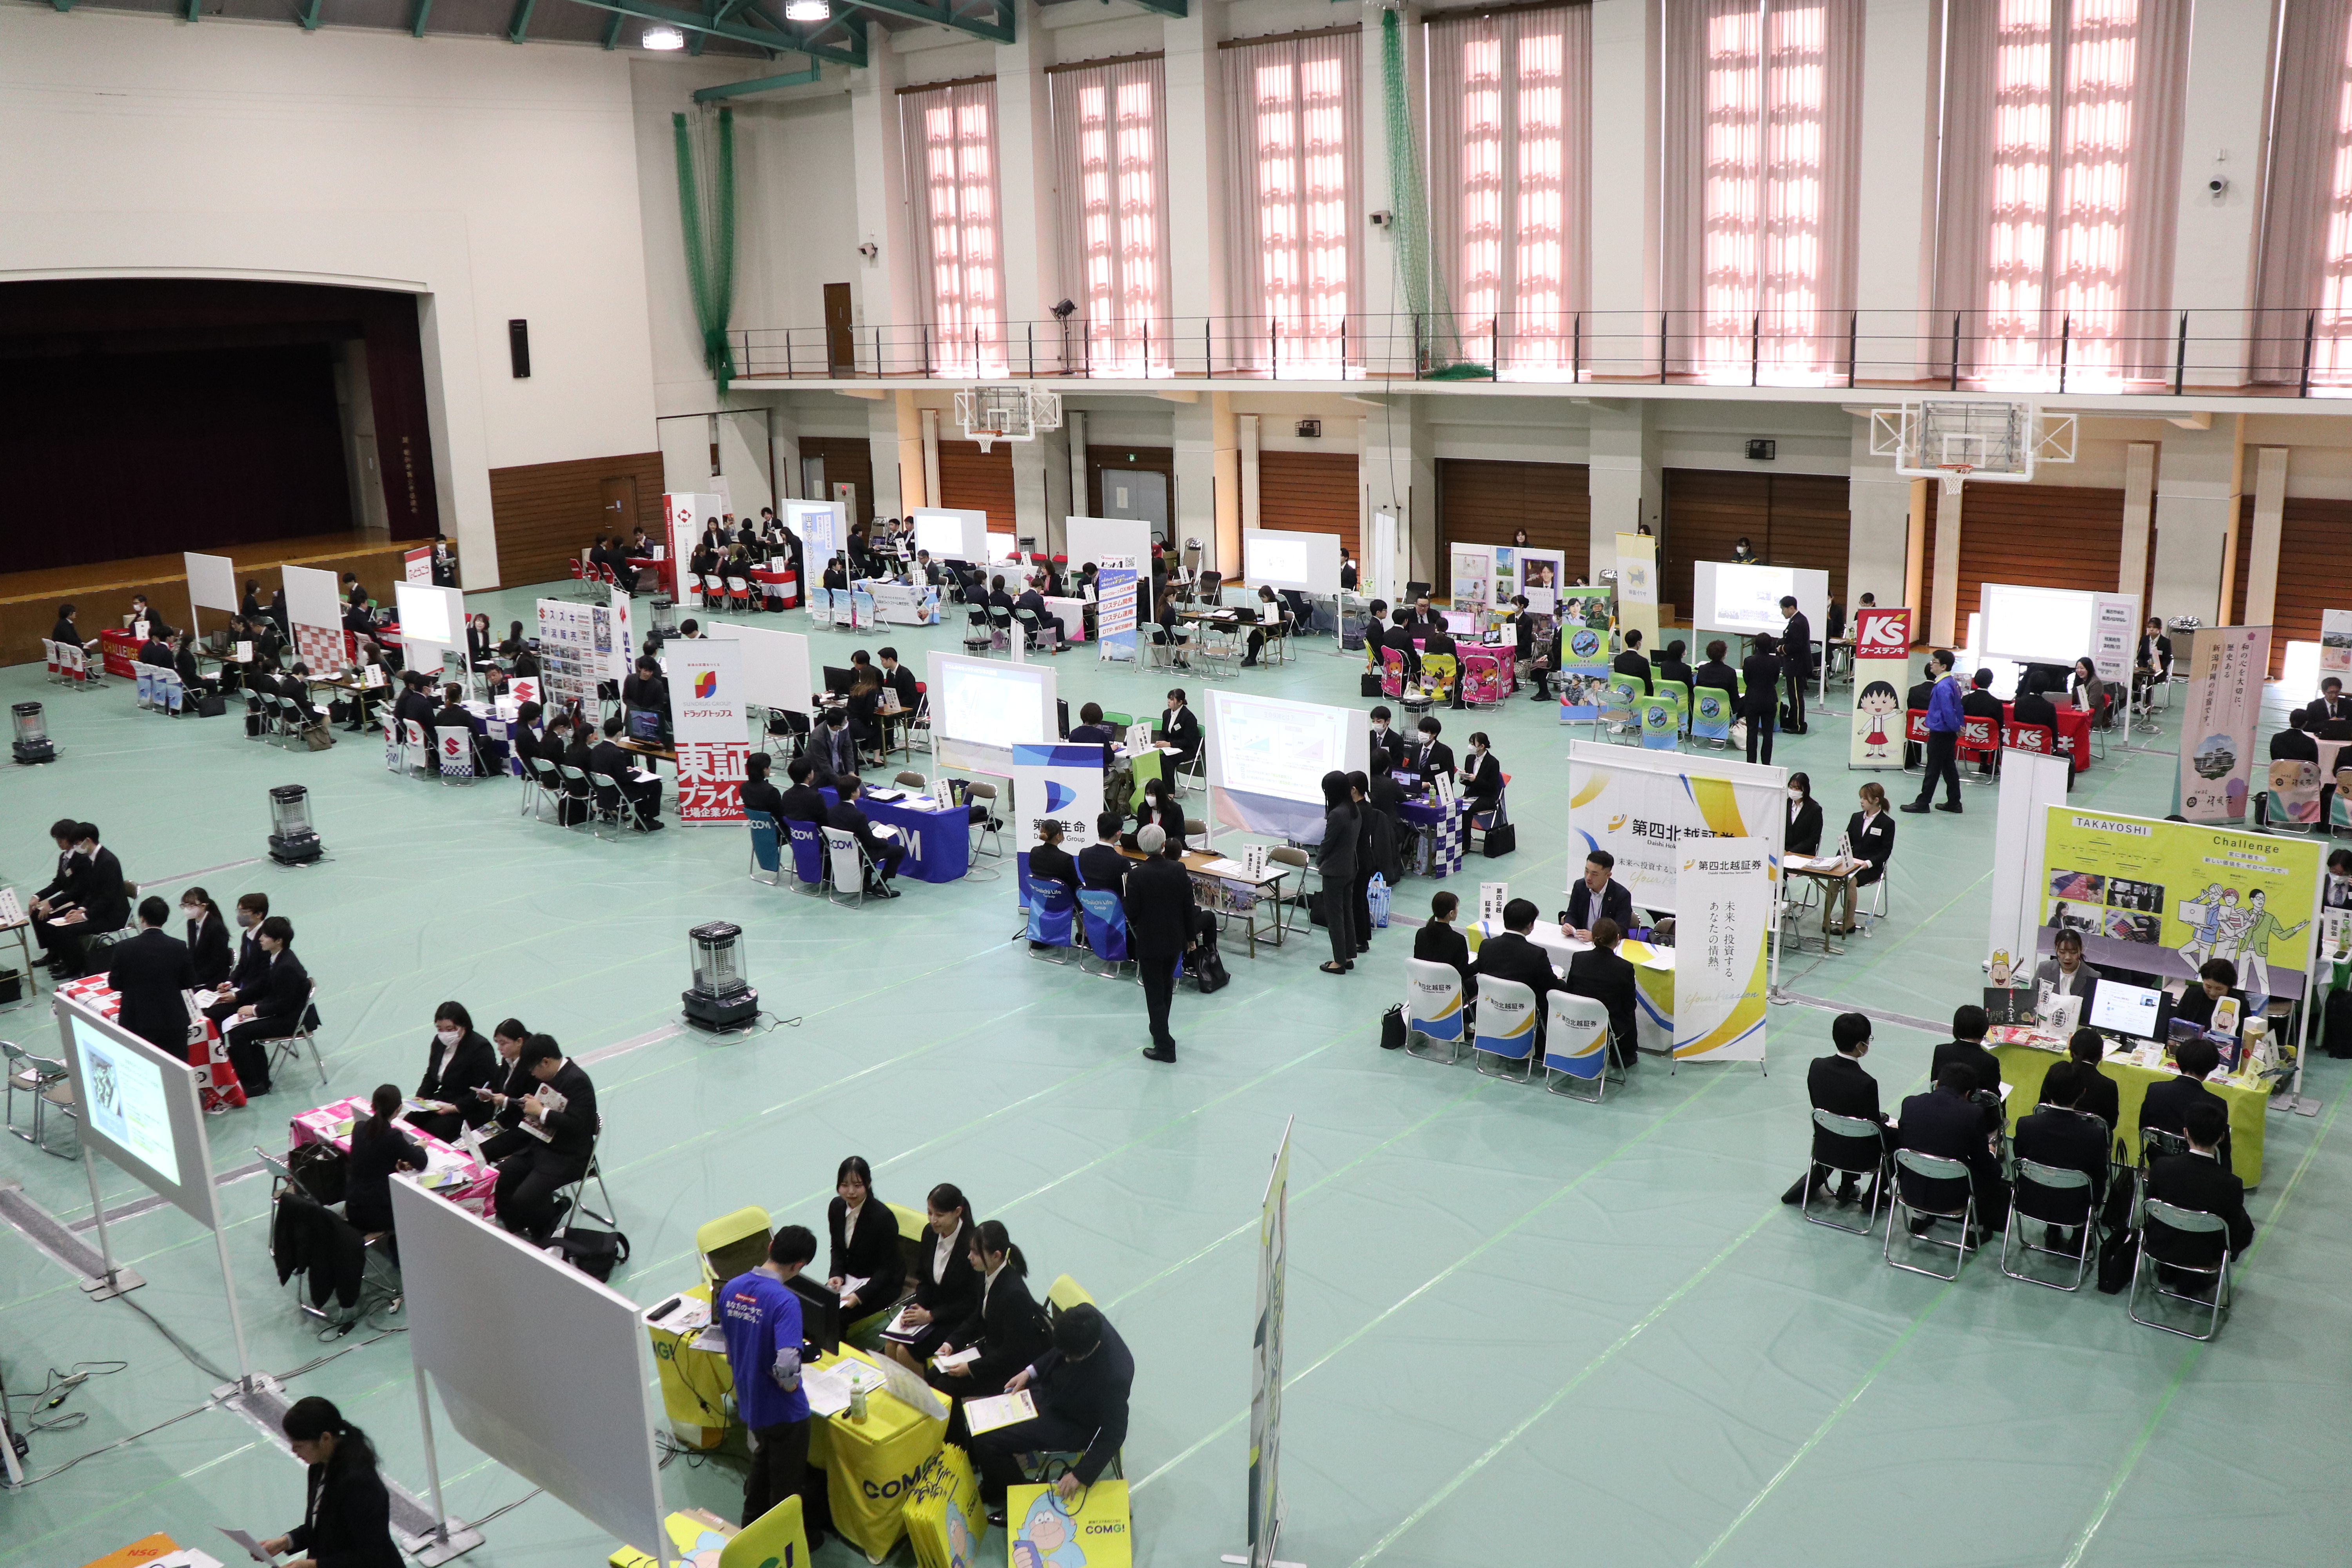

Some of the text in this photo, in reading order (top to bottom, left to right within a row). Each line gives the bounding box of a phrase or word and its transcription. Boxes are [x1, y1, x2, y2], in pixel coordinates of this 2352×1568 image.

[1102, 597, 1133, 610] システム開発
[550, 610, 575, 624] スズキ
[1102, 609, 1133, 622] システム運用
[541, 626, 577, 642] 新潟販売
[1860, 646, 1905, 654] ケーズデンキ
[2223, 644, 2235, 679] 歴史ある
[2234, 643, 2250, 708] 和の心を大切に、
[2203, 644, 2221, 727] 新潟月岡のお宿です。
[676, 742, 749, 782] 東証
[681, 806, 744, 818] 上場企業グルー
[748, 819, 771, 829] COM
[1032, 818, 1086, 833] 第生命
[2077, 817, 2147, 835] TAKAYOSHI
[790, 828, 813, 840] COM
[829, 839, 853, 850] COM
[2213, 835, 2280, 853] Challenge
[2228, 851, 2265, 861] 常に挑戦を。
[1698, 860, 1762, 870] 第四北越証券
[2204, 857, 2288, 875] 新しい価値を、ゼロベースで。
[2330, 919, 2339, 936] 福祉会
[1708, 902, 1719, 971] あなたの情熱。
[1723, 901, 1736, 982] 未来へ投資する、
[1418, 982, 1451, 991] 第四北越証券
[1490, 998, 1525, 1009] 第四北越証券
[1684, 991, 1759, 1014] Your Passion
[1562, 1015, 1597, 1027] 第四北越証券
[726, 1300, 763, 1318] あなたの一歩で、
[1085, 1523, 1125, 1535] COMG!
